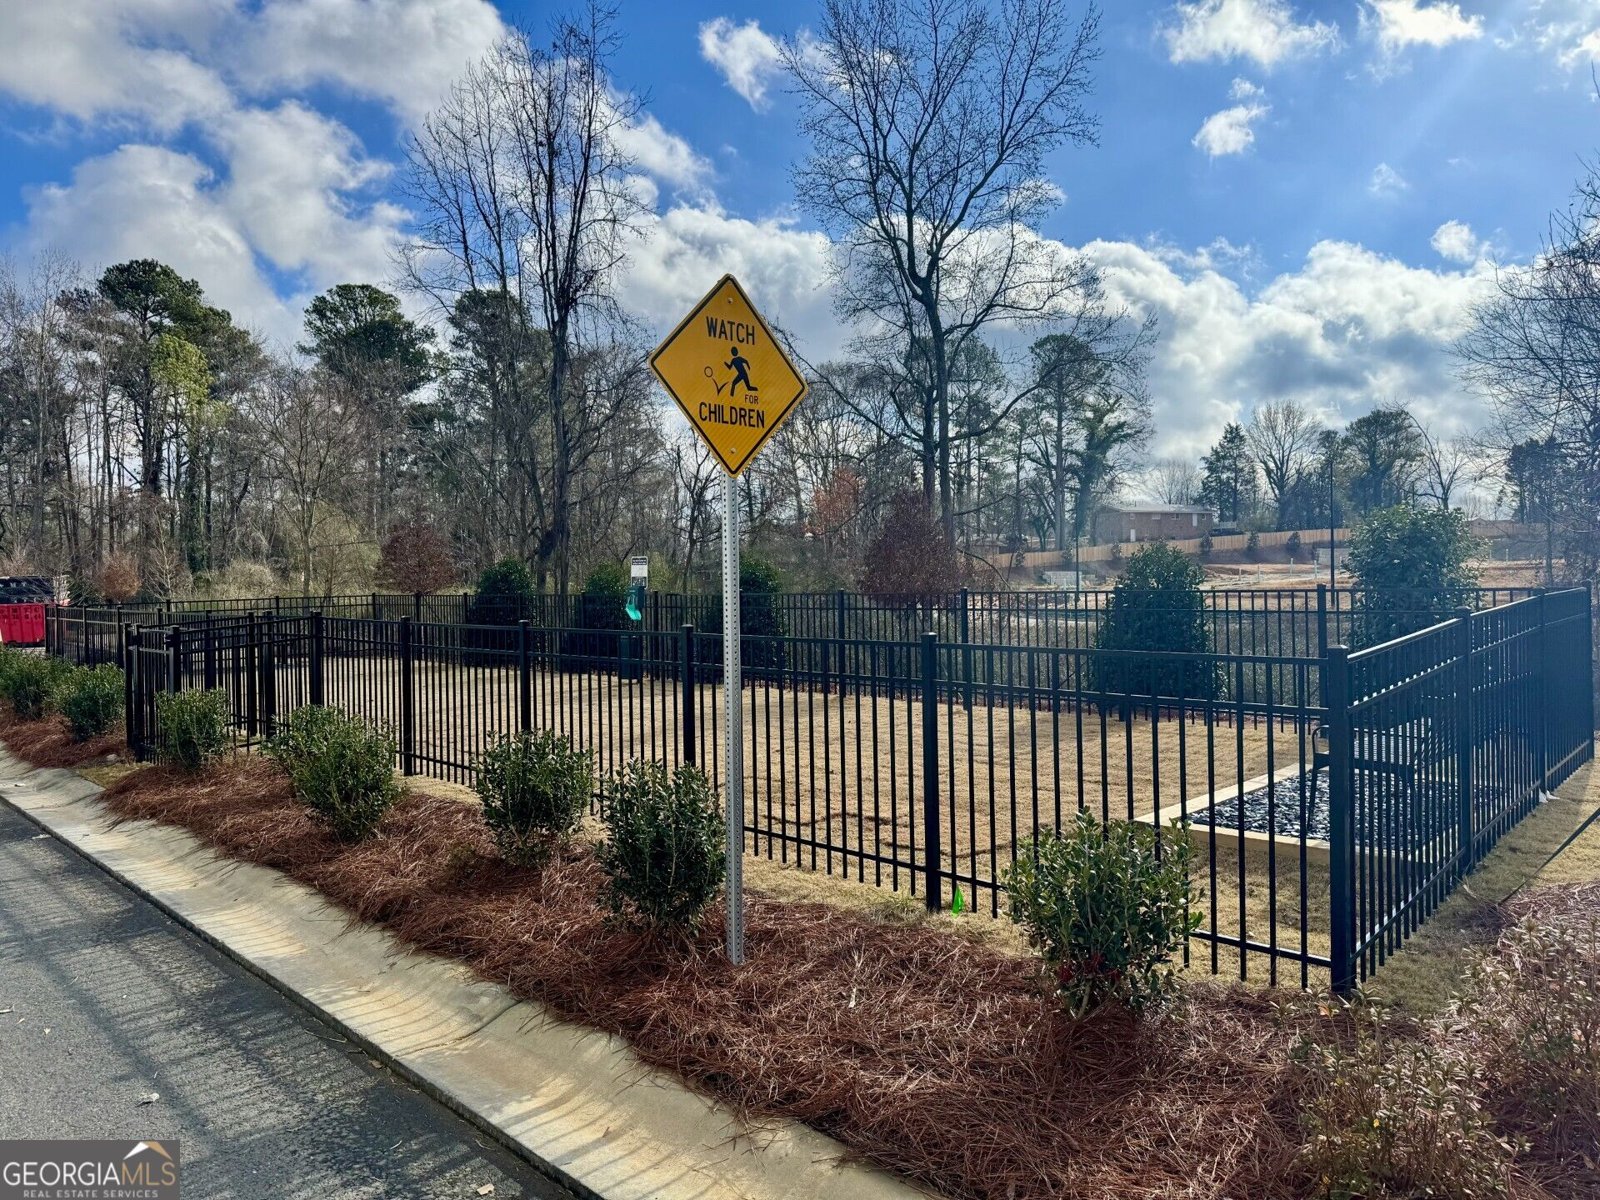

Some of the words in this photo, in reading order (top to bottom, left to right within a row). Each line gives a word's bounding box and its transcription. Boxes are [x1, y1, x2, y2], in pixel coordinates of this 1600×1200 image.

[706, 316, 755, 345] WATCH
[744, 394, 759, 404] FOR
[699, 402, 765, 428] CHILDREN
